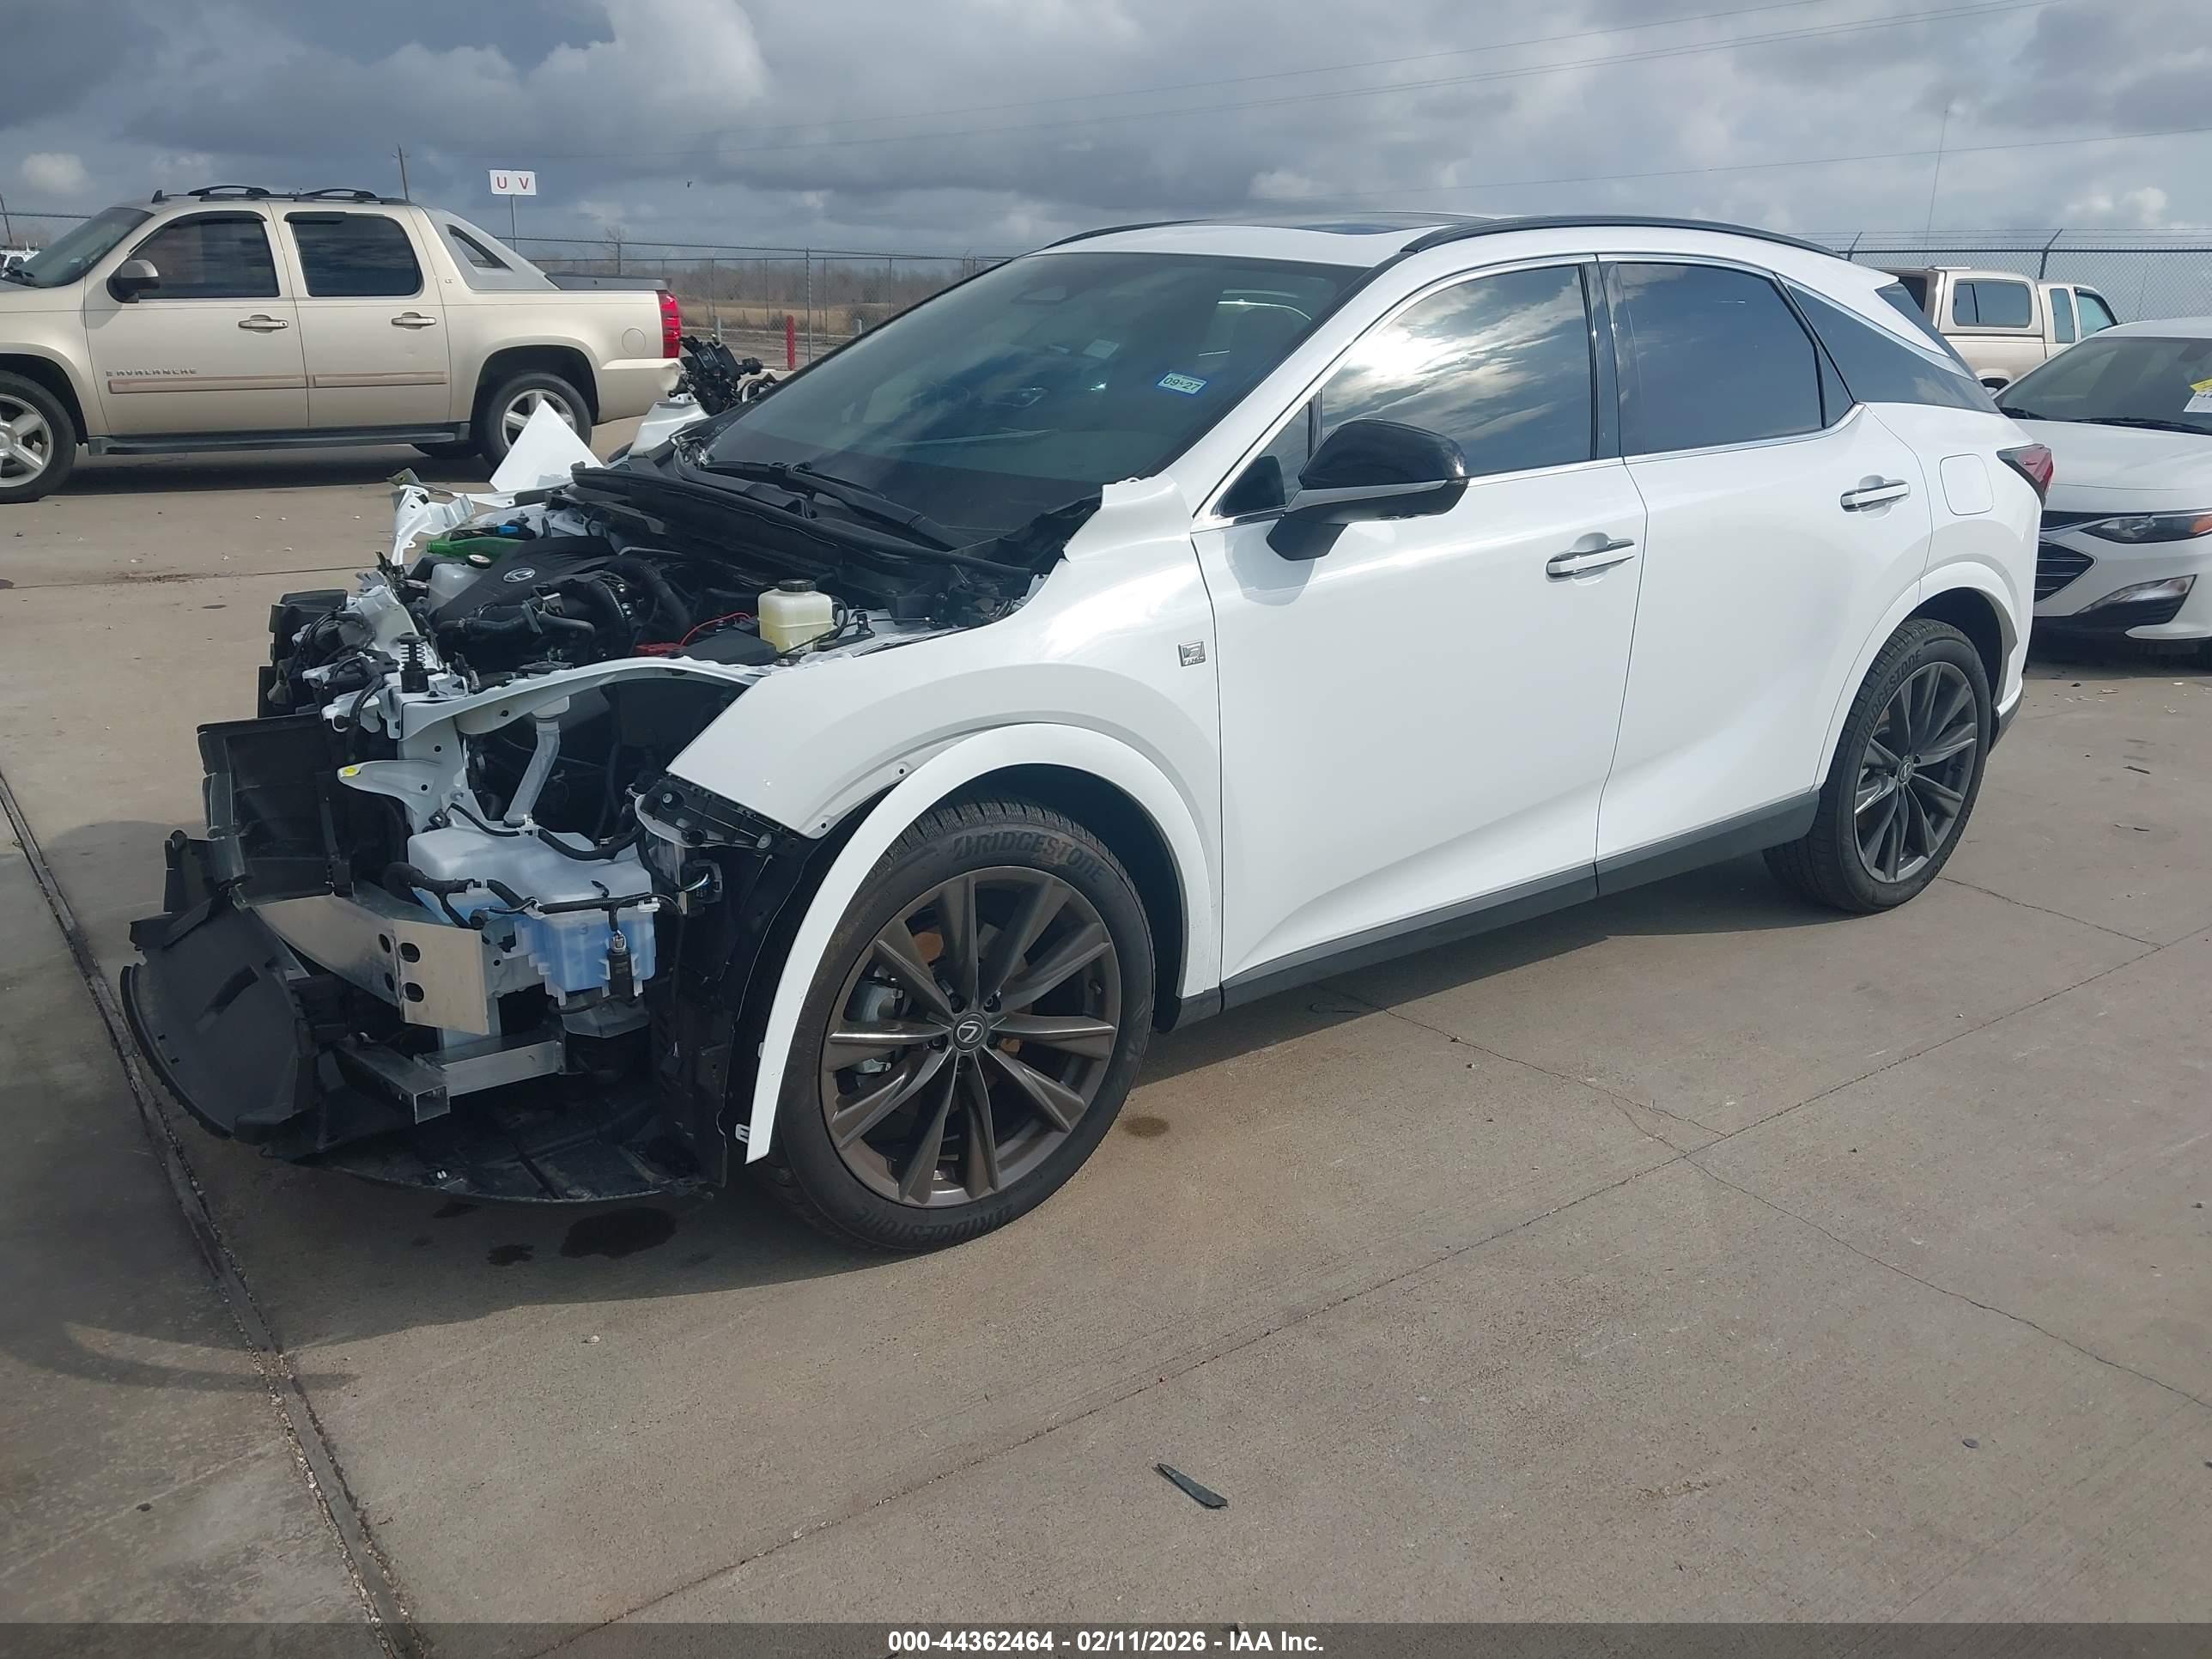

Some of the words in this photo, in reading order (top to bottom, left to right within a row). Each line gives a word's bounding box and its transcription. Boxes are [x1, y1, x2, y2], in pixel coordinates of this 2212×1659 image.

[496, 176, 507, 189] U
[518, 177, 529, 190] V
[116, 368, 198, 377] AVALANCHE
[953, 830, 1108, 883] BRIDGESTONE
